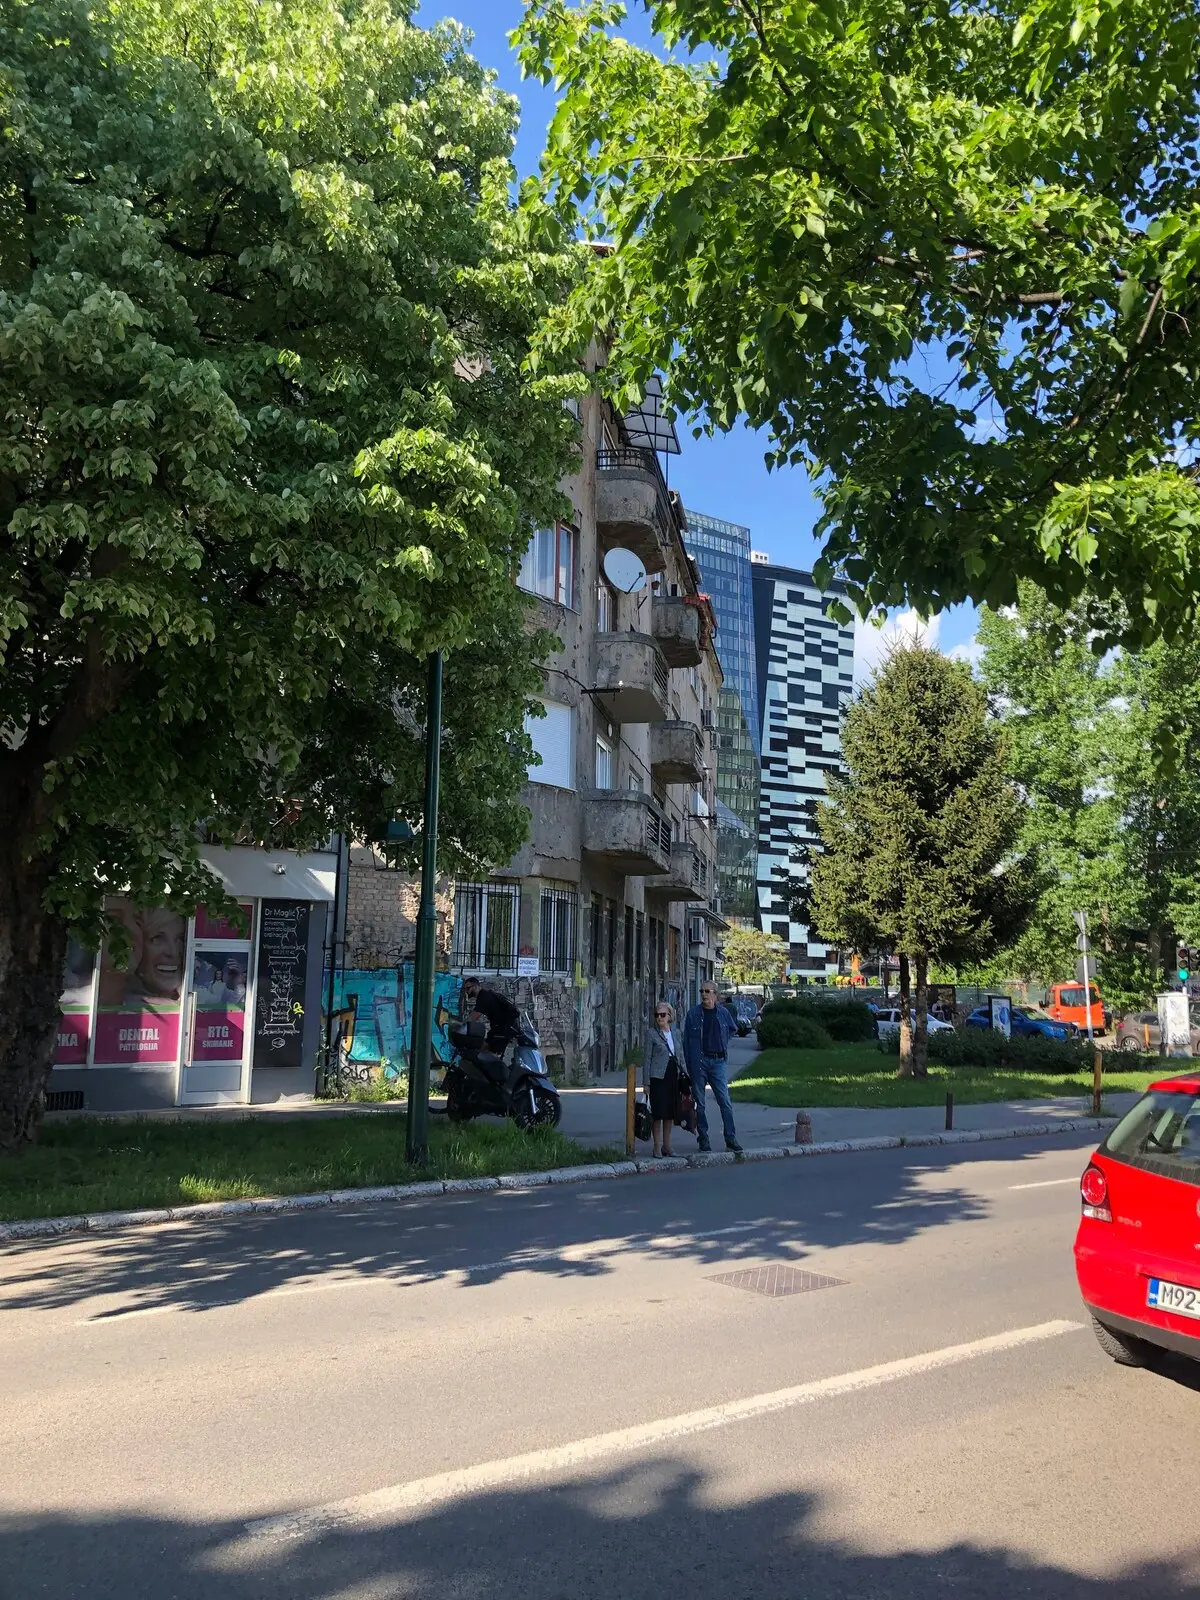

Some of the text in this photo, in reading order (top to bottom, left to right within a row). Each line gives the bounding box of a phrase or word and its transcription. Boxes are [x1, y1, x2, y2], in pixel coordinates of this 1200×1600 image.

[264, 908, 272, 916] Dr
[119, 1028, 159, 1041] DENTAL
[207, 1025, 229, 1038] RTG
[119, 1042, 159, 1051] PATOLOGIJA
[202, 1039, 233, 1048] SNIMANJE
